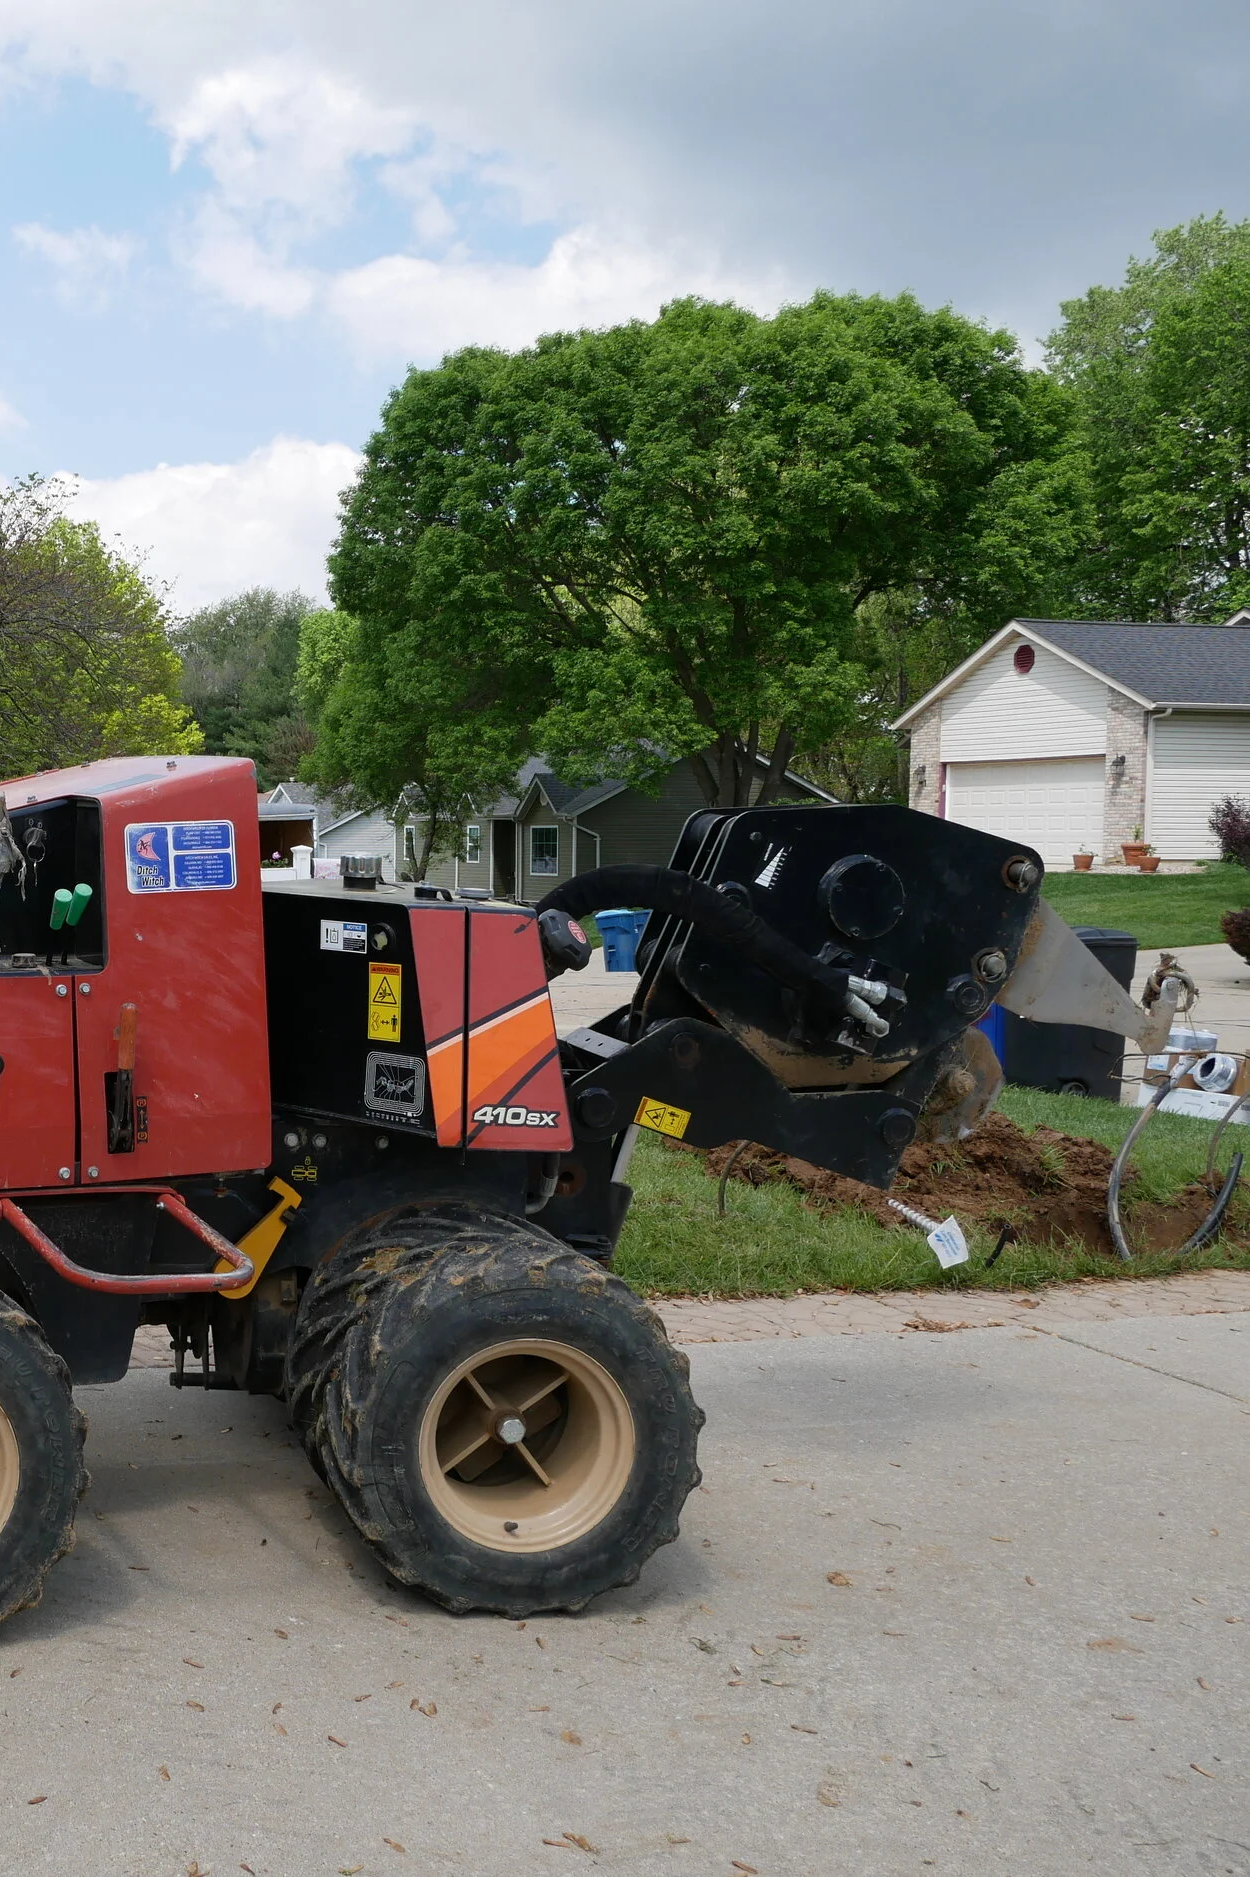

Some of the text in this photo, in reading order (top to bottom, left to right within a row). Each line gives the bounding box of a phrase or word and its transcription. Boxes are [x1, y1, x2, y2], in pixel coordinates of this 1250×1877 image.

[136, 864, 158, 876] Ditch
[141, 875, 165, 887] Witch
[376, 966, 400, 974] WARNING
